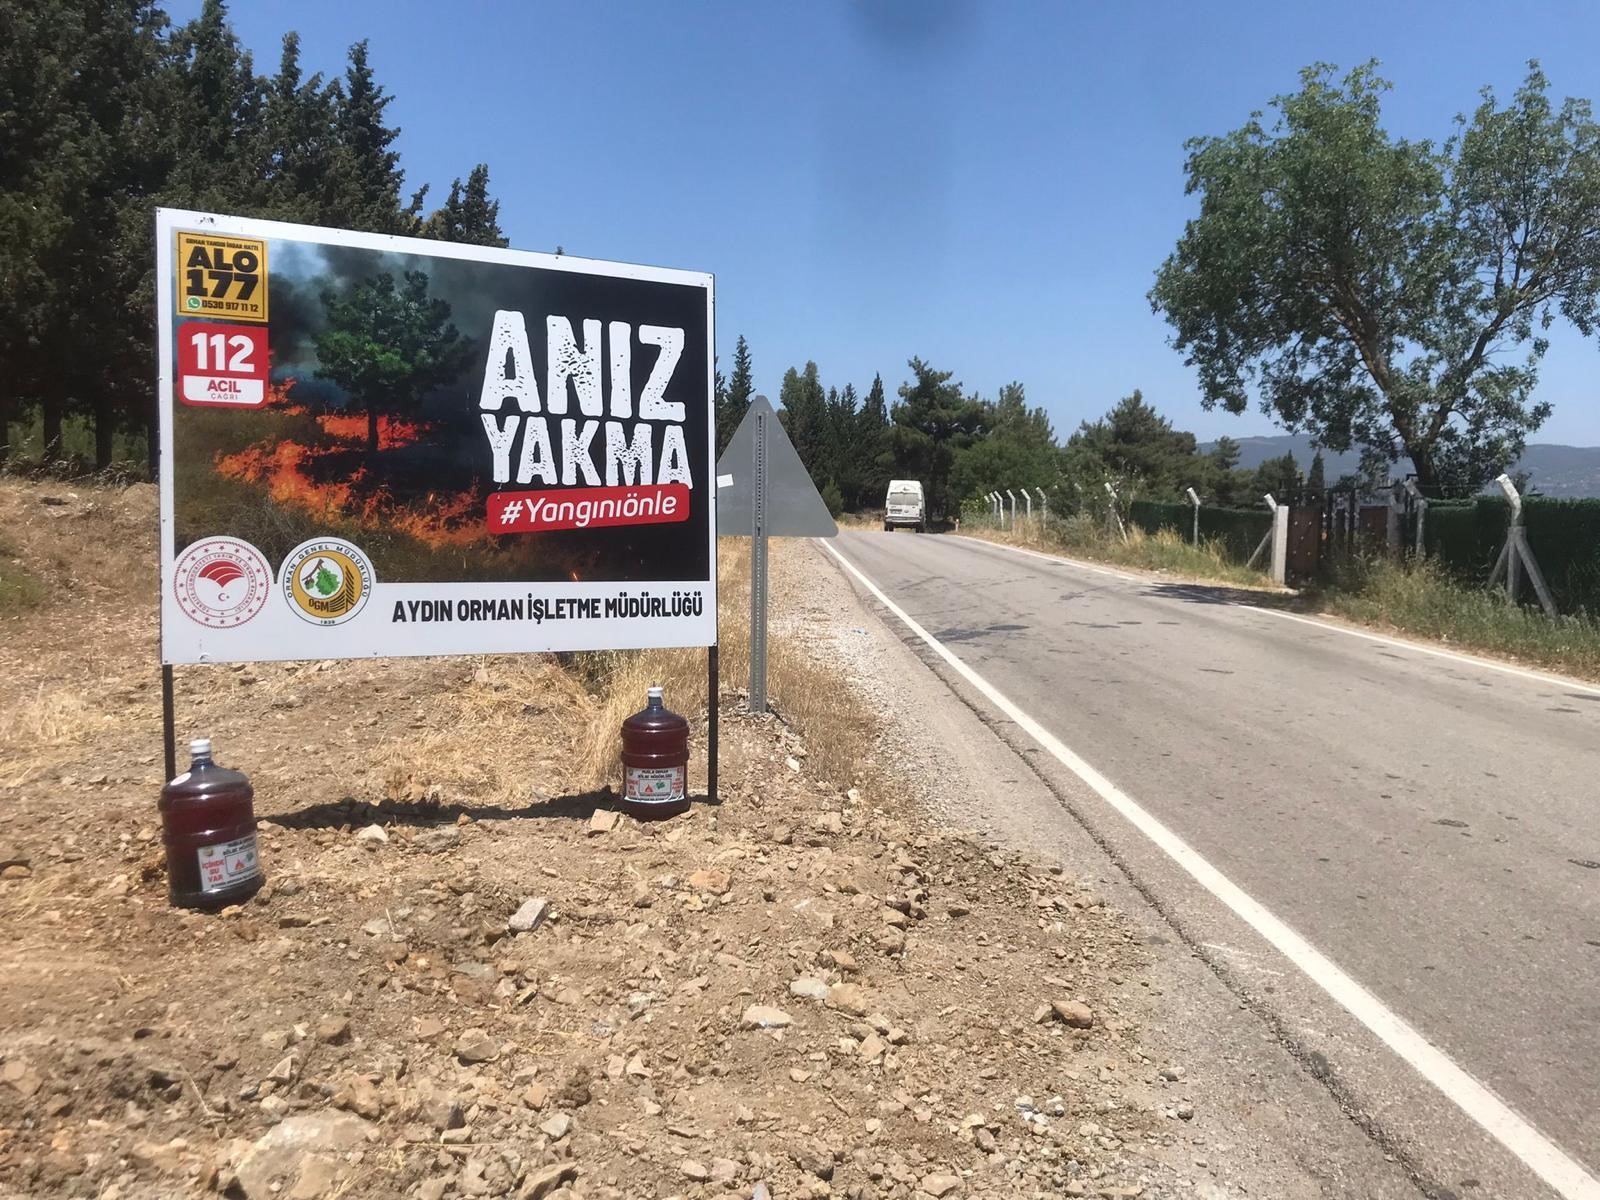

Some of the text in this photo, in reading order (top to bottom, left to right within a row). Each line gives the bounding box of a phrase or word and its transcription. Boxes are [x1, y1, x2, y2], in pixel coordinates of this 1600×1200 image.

[187, 246, 258, 273] ALO
[186, 269, 258, 300] 177
[202, 300, 258, 312] 0530 917 11 12
[192, 332, 254, 372] 112
[479, 309, 686, 422] ANIZ
[480, 413, 693, 490] YAKMA
[500, 491, 677, 527] #Yangınıönle
[286, 564, 296, 598] ORMAN
[298, 545, 330, 560] GENEL
[308, 598, 330, 612] OGM
[392, 591, 702, 624] AYDIN ORMAN İŞLETME MÜDÜRLÜĞÜ
